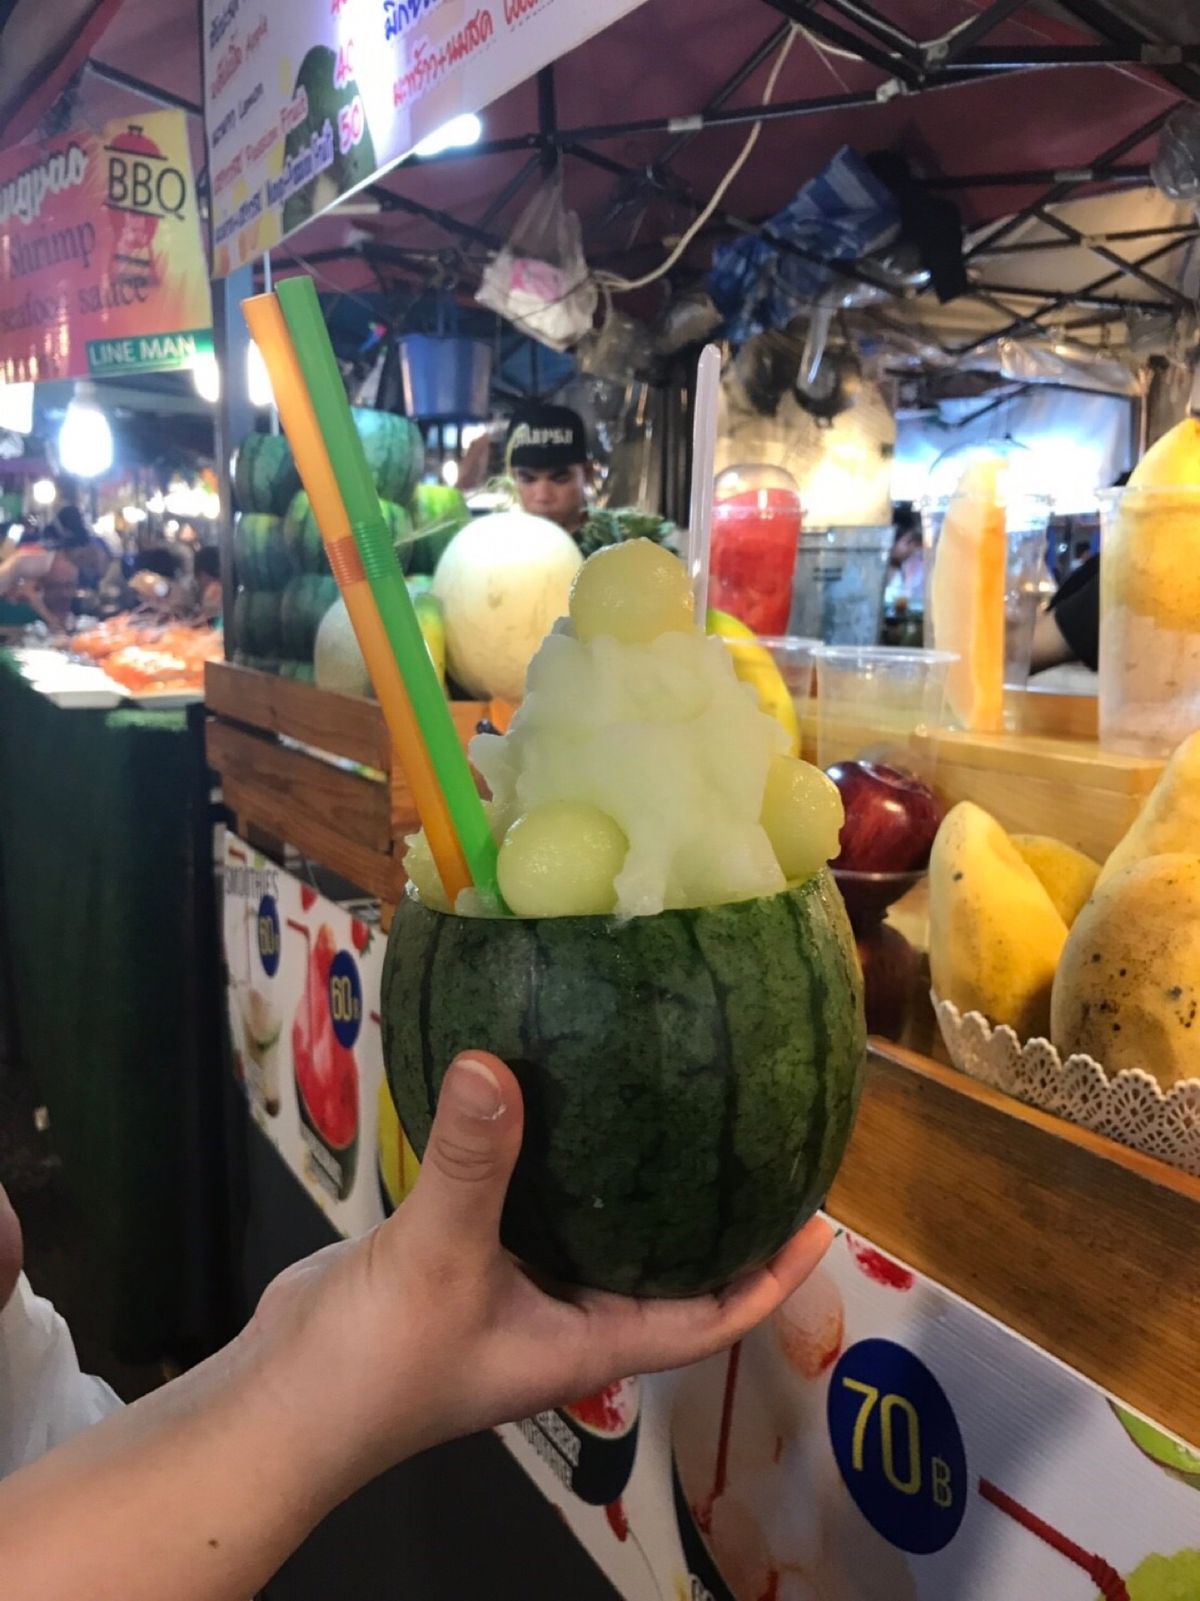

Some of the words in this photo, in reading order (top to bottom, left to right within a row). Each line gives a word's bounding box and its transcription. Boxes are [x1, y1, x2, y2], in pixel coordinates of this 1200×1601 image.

[339, 102, 361, 149] 50
[108, 156, 187, 221] BBQ
[90, 341, 136, 366] LINE
[142, 335, 197, 360] MAN
[331, 975, 353, 1021] 60
[842, 1376, 922, 1495] 70
[931, 1456, 953, 1508] B
